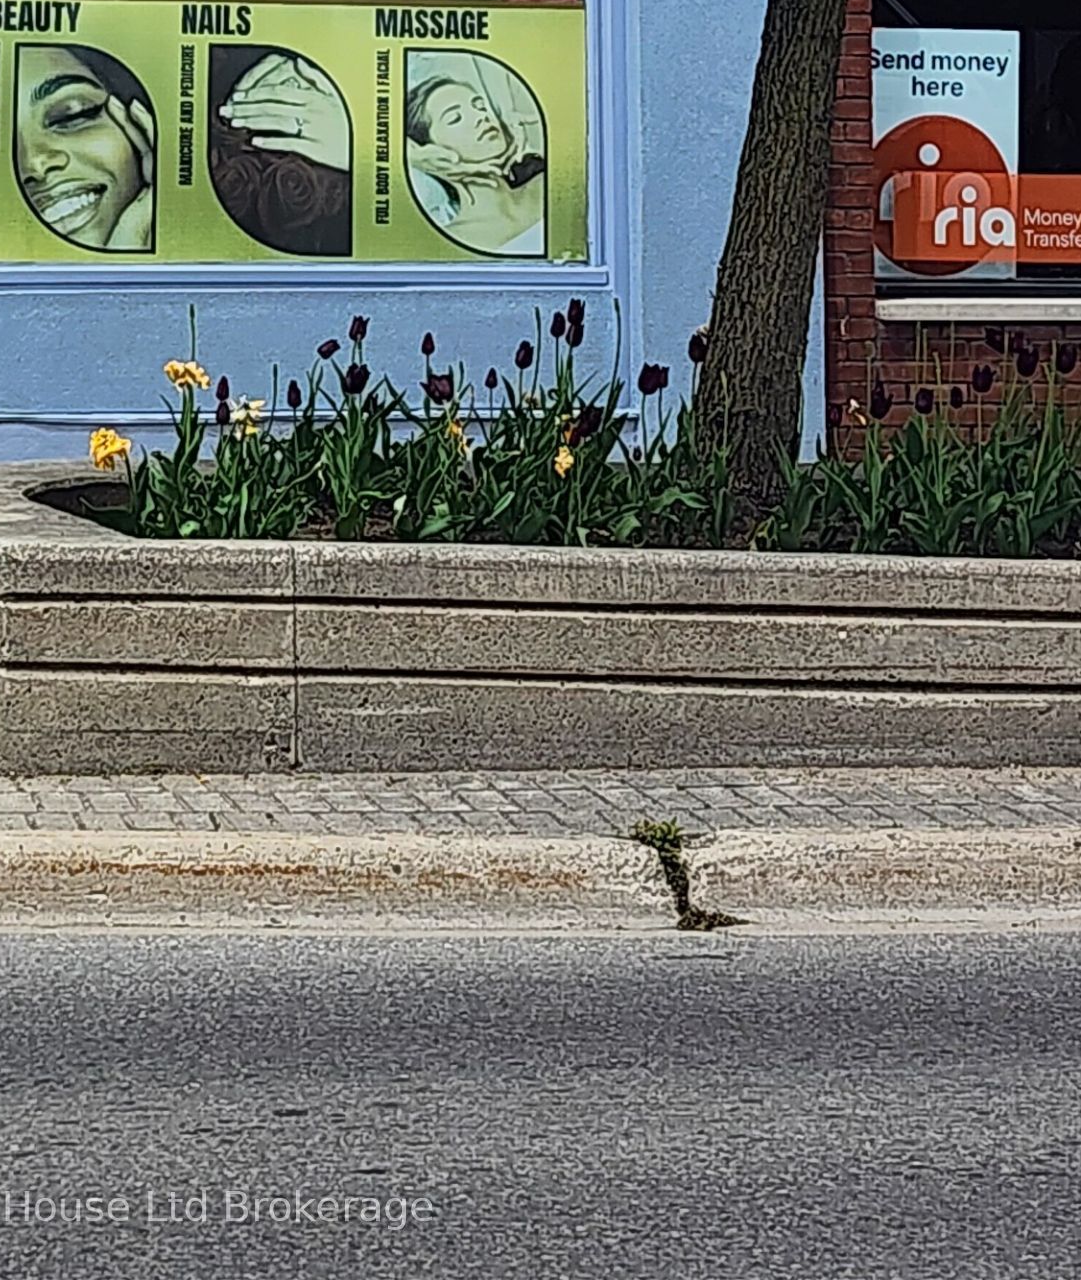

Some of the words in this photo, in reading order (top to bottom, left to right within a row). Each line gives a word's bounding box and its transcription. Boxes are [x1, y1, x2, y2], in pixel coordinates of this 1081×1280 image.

[181, 4, 252, 36] NAILS
[375, 9, 490, 40] MASSAGE
[180, 44, 195, 98] PEDICURE
[377, 48, 391, 86] FACIAL
[870, 49, 924, 70] Send
[931, 54, 1009, 76] money
[911, 76, 964, 97] here
[180, 101, 193, 124] AND
[376, 96, 390, 162] RELAXATION
[179, 126, 193, 186] MANICURE
[376, 165, 390, 195] BODY
[375, 199, 390, 224] FULL
[934, 186, 1017, 246] ria
[1024, 208, 1081, 230] Money
